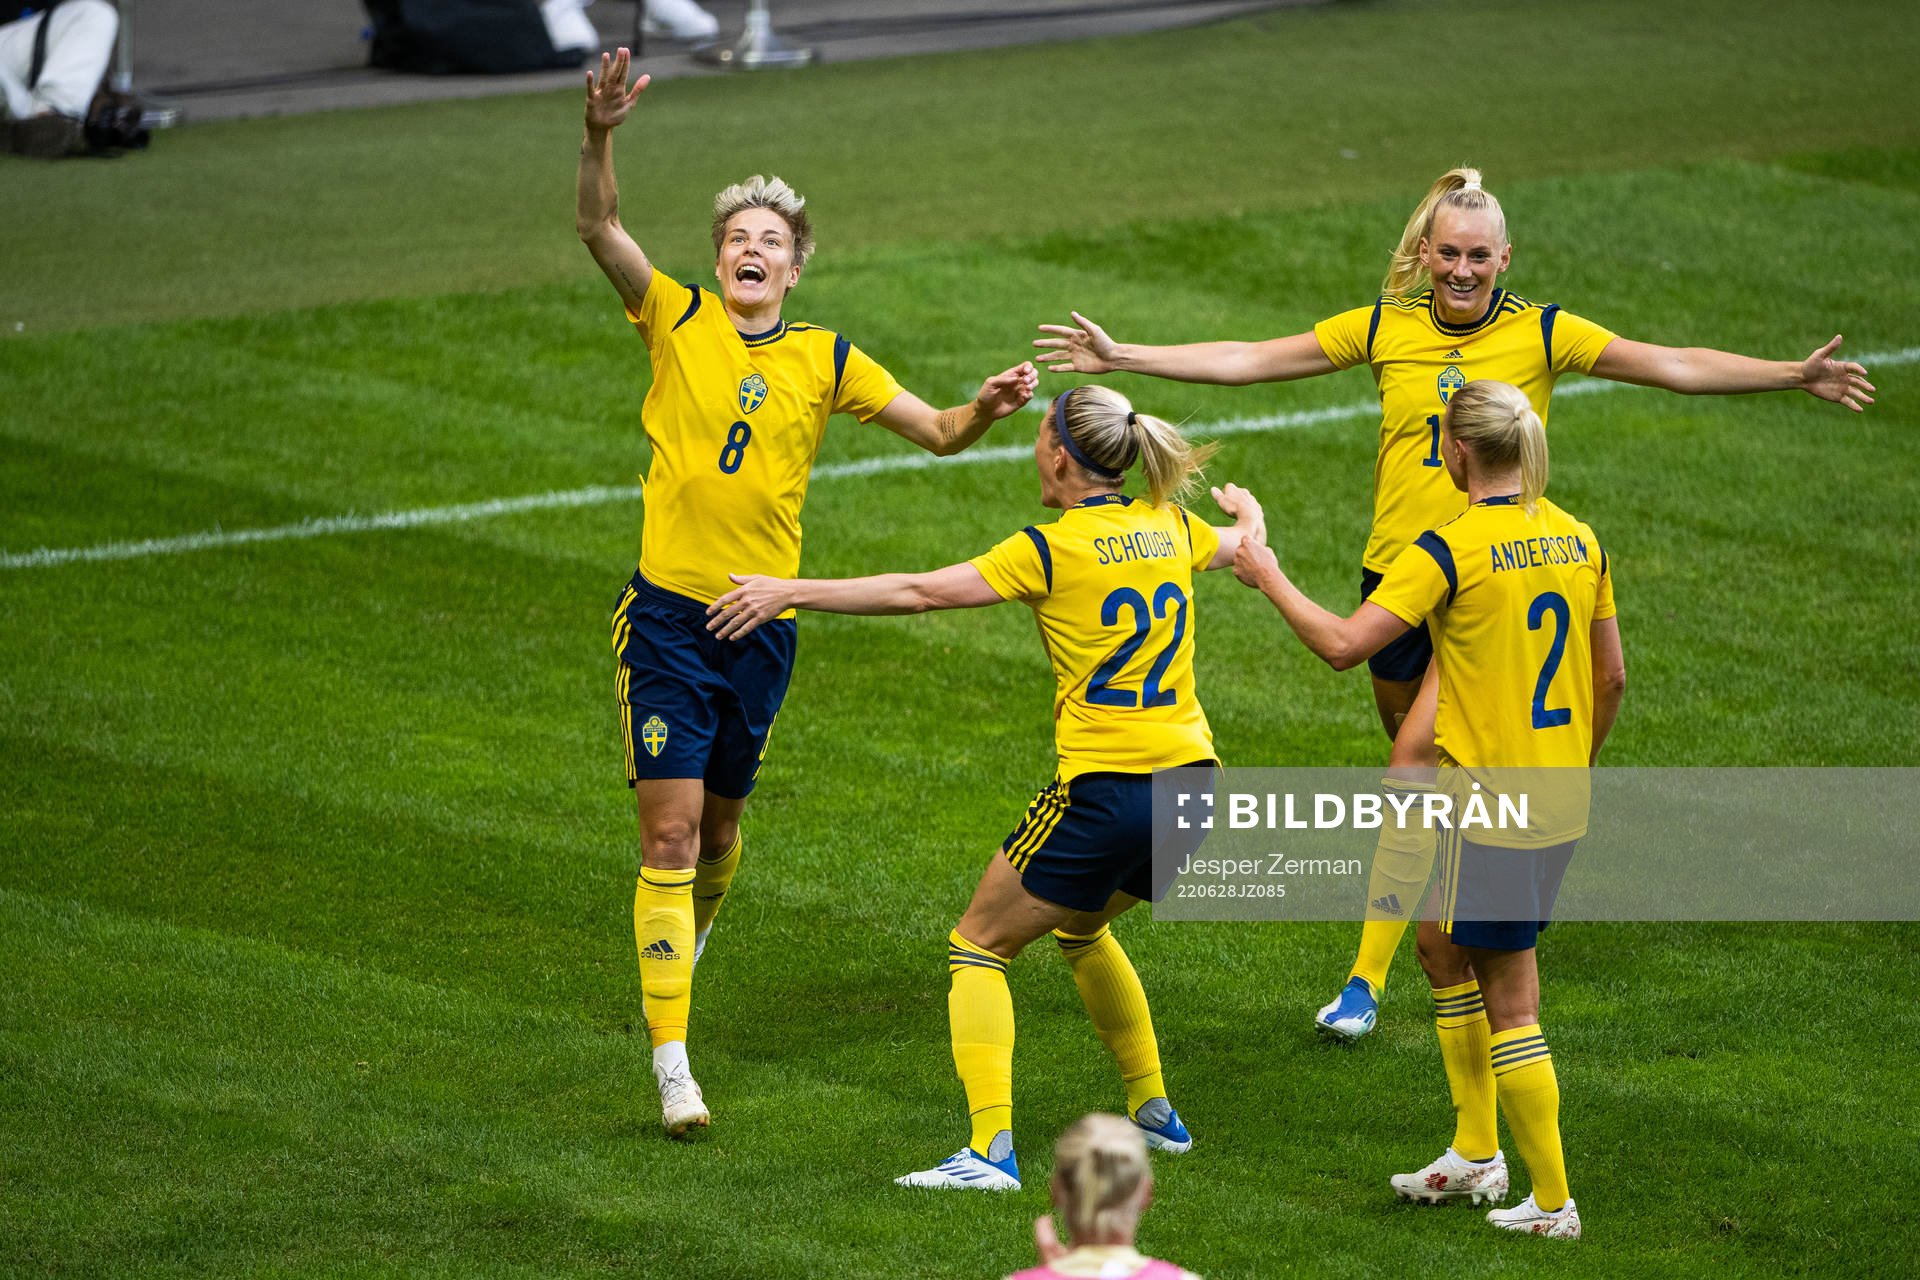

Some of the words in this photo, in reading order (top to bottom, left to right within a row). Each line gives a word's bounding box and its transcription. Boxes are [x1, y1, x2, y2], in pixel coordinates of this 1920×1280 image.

[718, 420, 752, 475] 8
[1094, 530, 1177, 565] SCHOUGH
[1490, 535, 1590, 573] ANDERSSON
[1085, 582, 1187, 709] 22
[1527, 591, 1572, 730] 2
[640, 950, 681, 961] adidas
